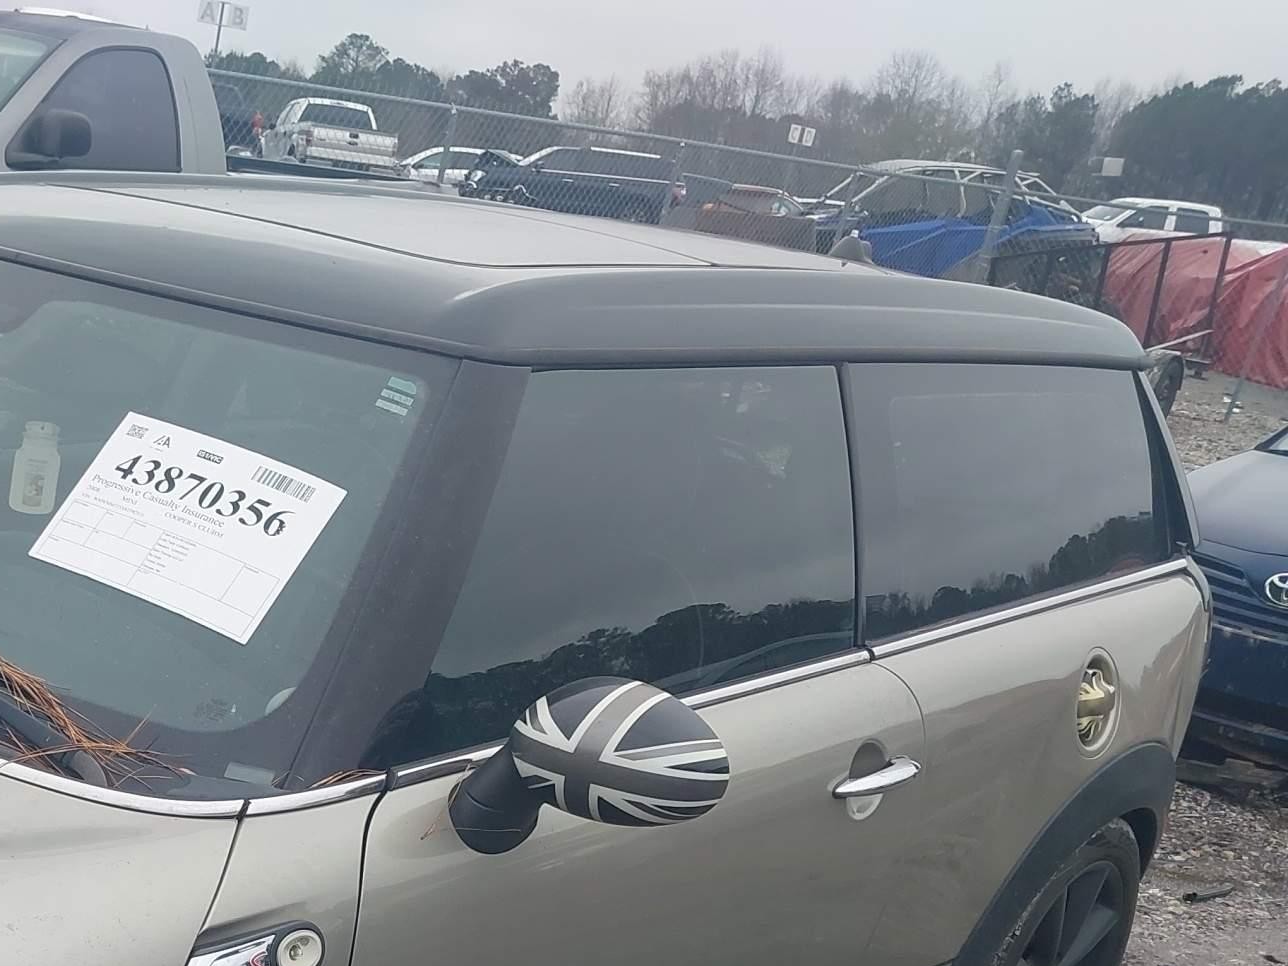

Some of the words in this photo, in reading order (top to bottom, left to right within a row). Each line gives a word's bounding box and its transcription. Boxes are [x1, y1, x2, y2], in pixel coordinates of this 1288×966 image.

[232, 7, 244, 25] B
[92, 474, 142, 497] Progressive
[143, 491, 181, 512] Casualty
[182, 505, 225, 528] Insurance
[115, 455, 296, 536] 43870356
